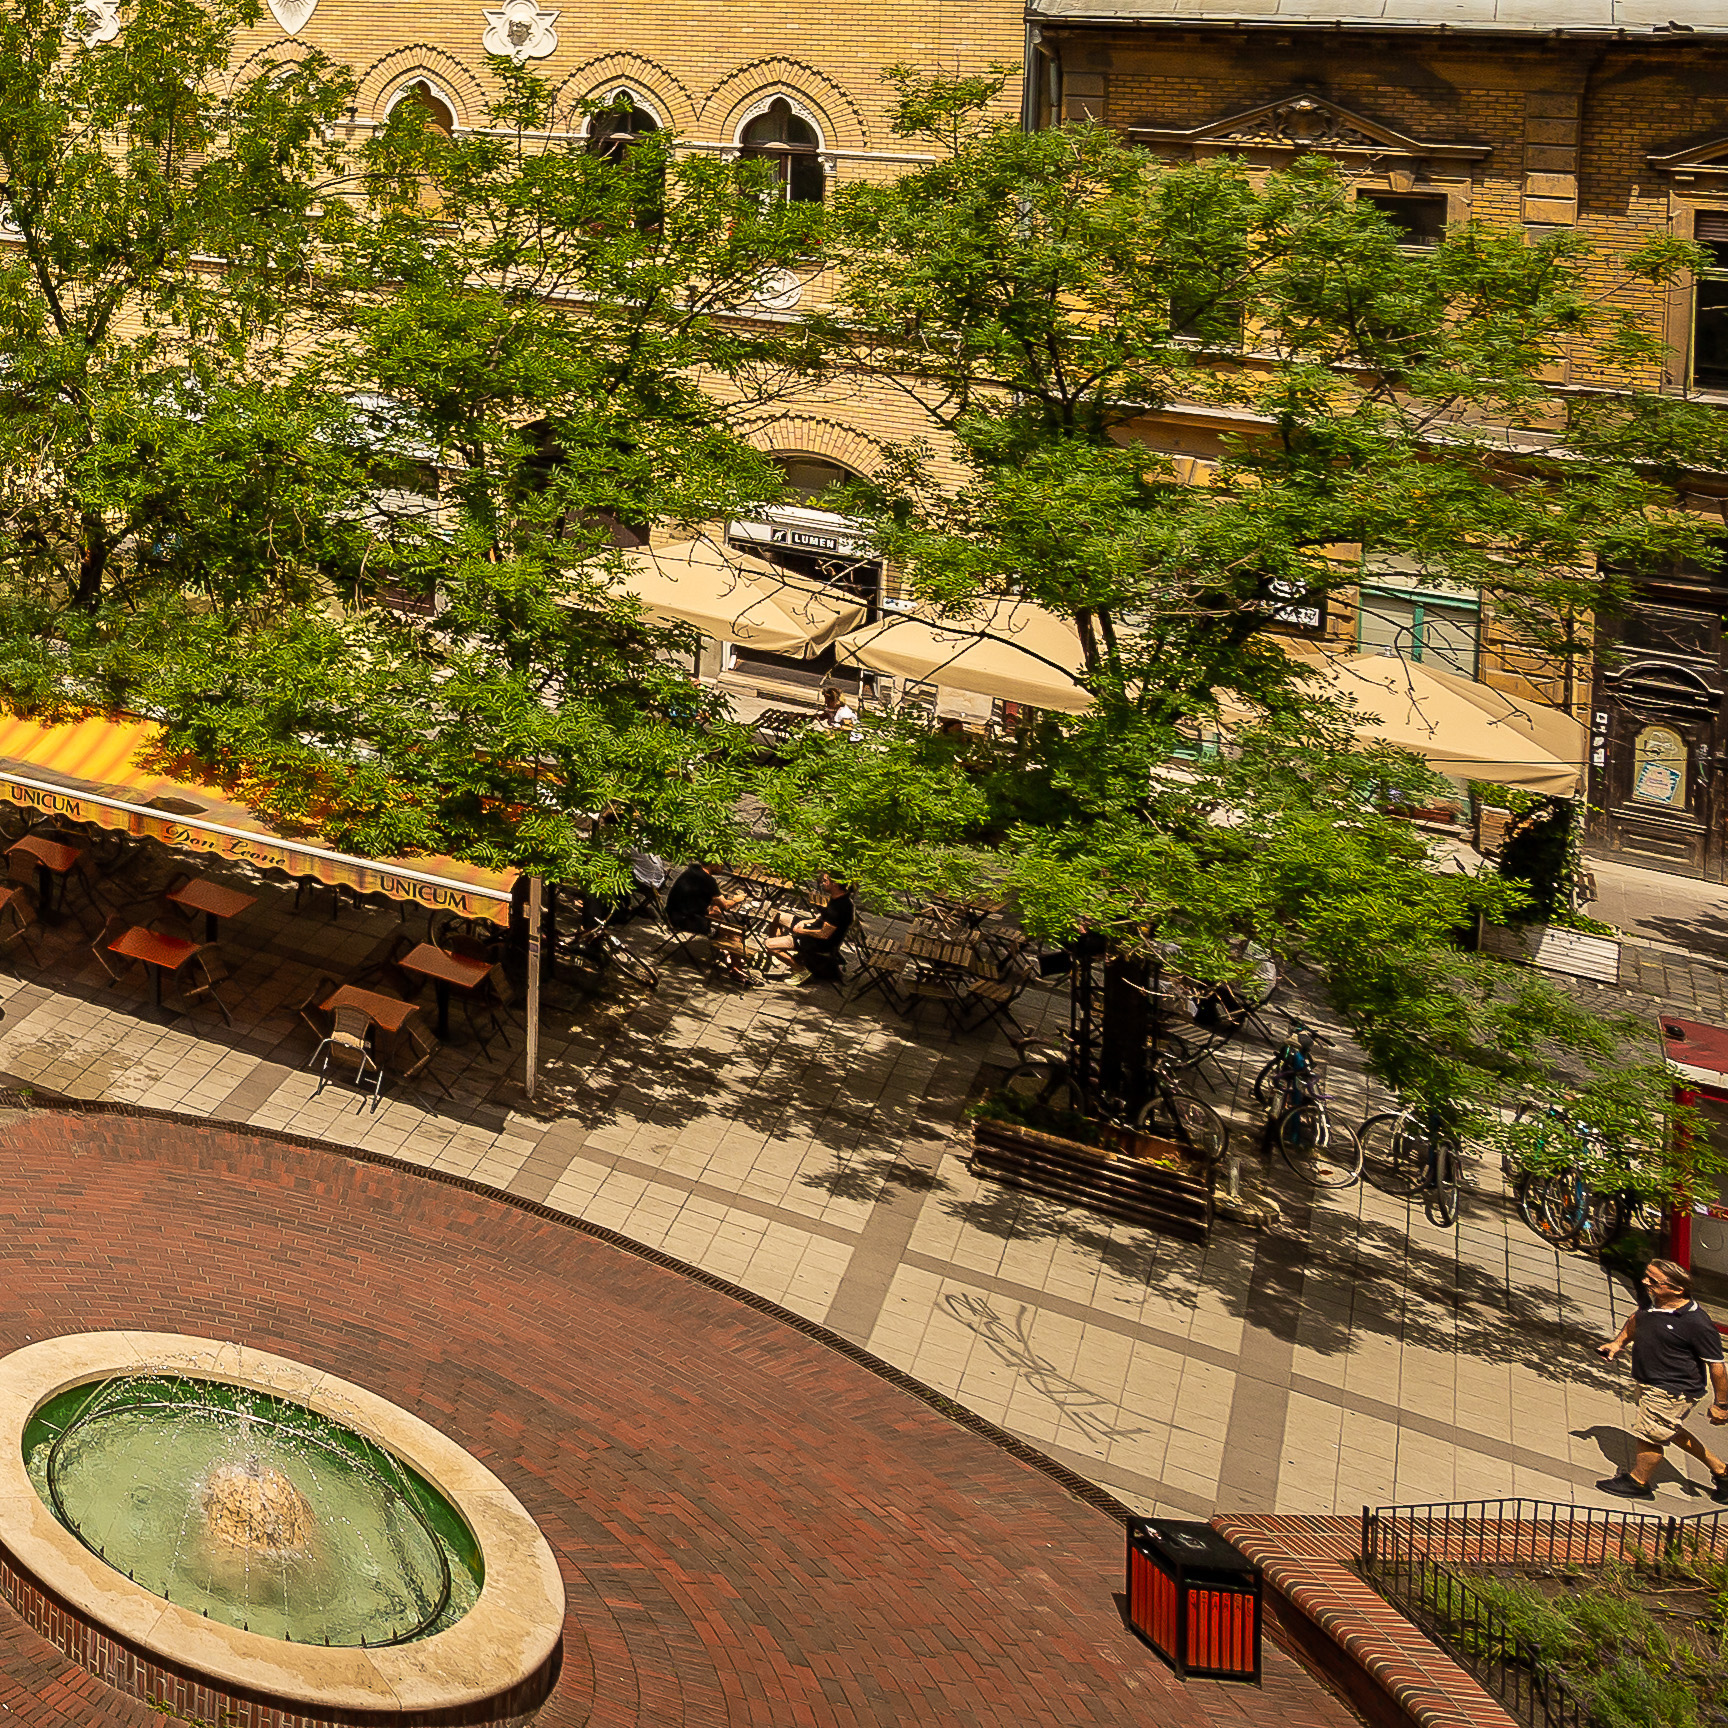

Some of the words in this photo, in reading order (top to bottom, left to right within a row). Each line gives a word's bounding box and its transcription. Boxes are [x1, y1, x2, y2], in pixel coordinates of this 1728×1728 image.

[794, 533, 835, 549] LUMEN
[10, 785, 81, 817] UNICUM
[163, 824, 215, 849] Don
[221, 838, 286, 867] Leone
[380, 875, 468, 911] UNICUM
